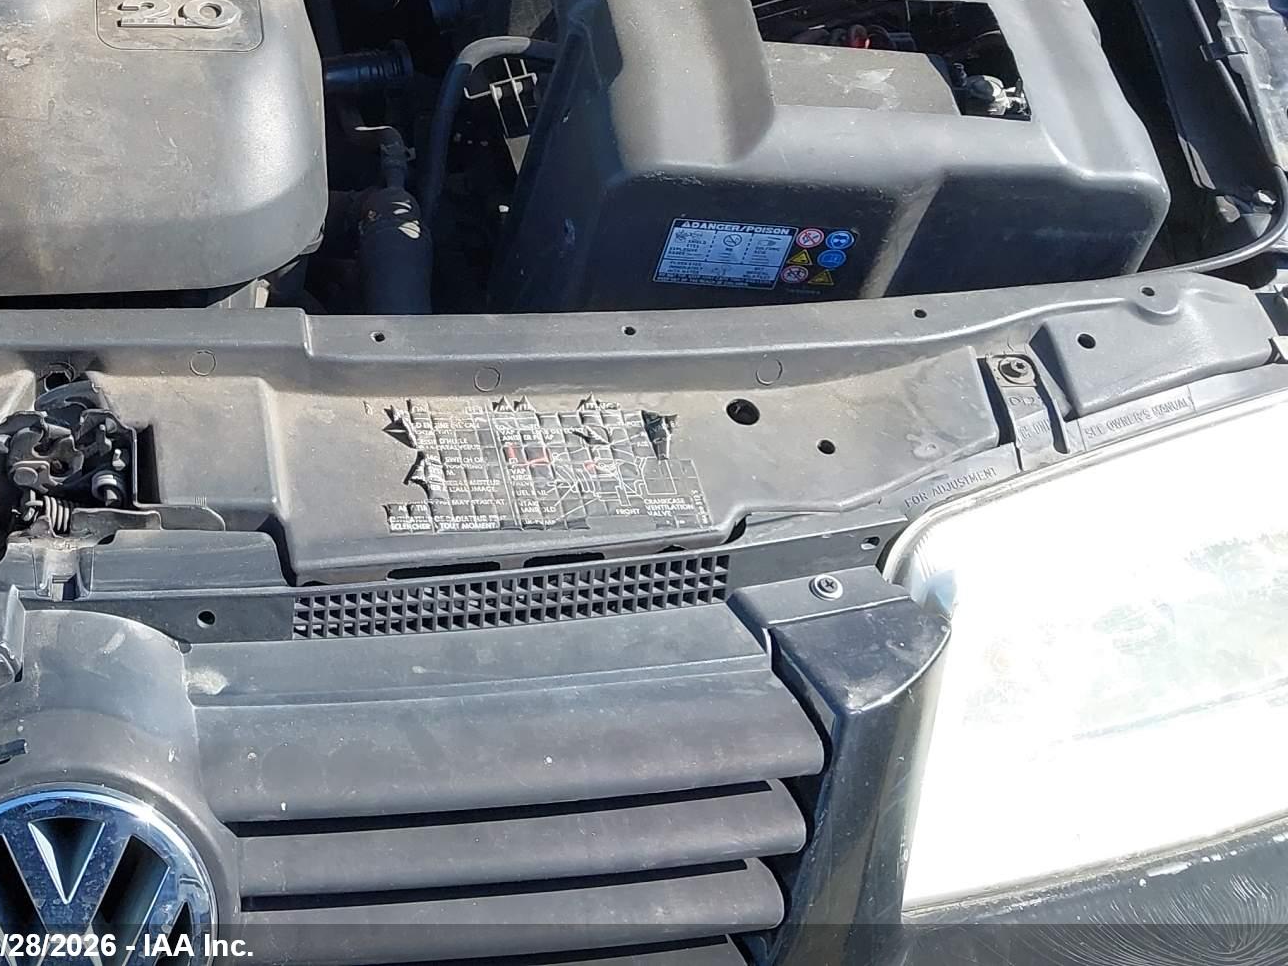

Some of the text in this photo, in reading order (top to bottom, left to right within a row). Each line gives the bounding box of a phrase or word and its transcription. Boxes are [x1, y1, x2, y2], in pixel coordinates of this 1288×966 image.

[690, 222, 790, 235] DANGER/POISON
[903, 467, 998, 509] FOR ADJUSTMENT
